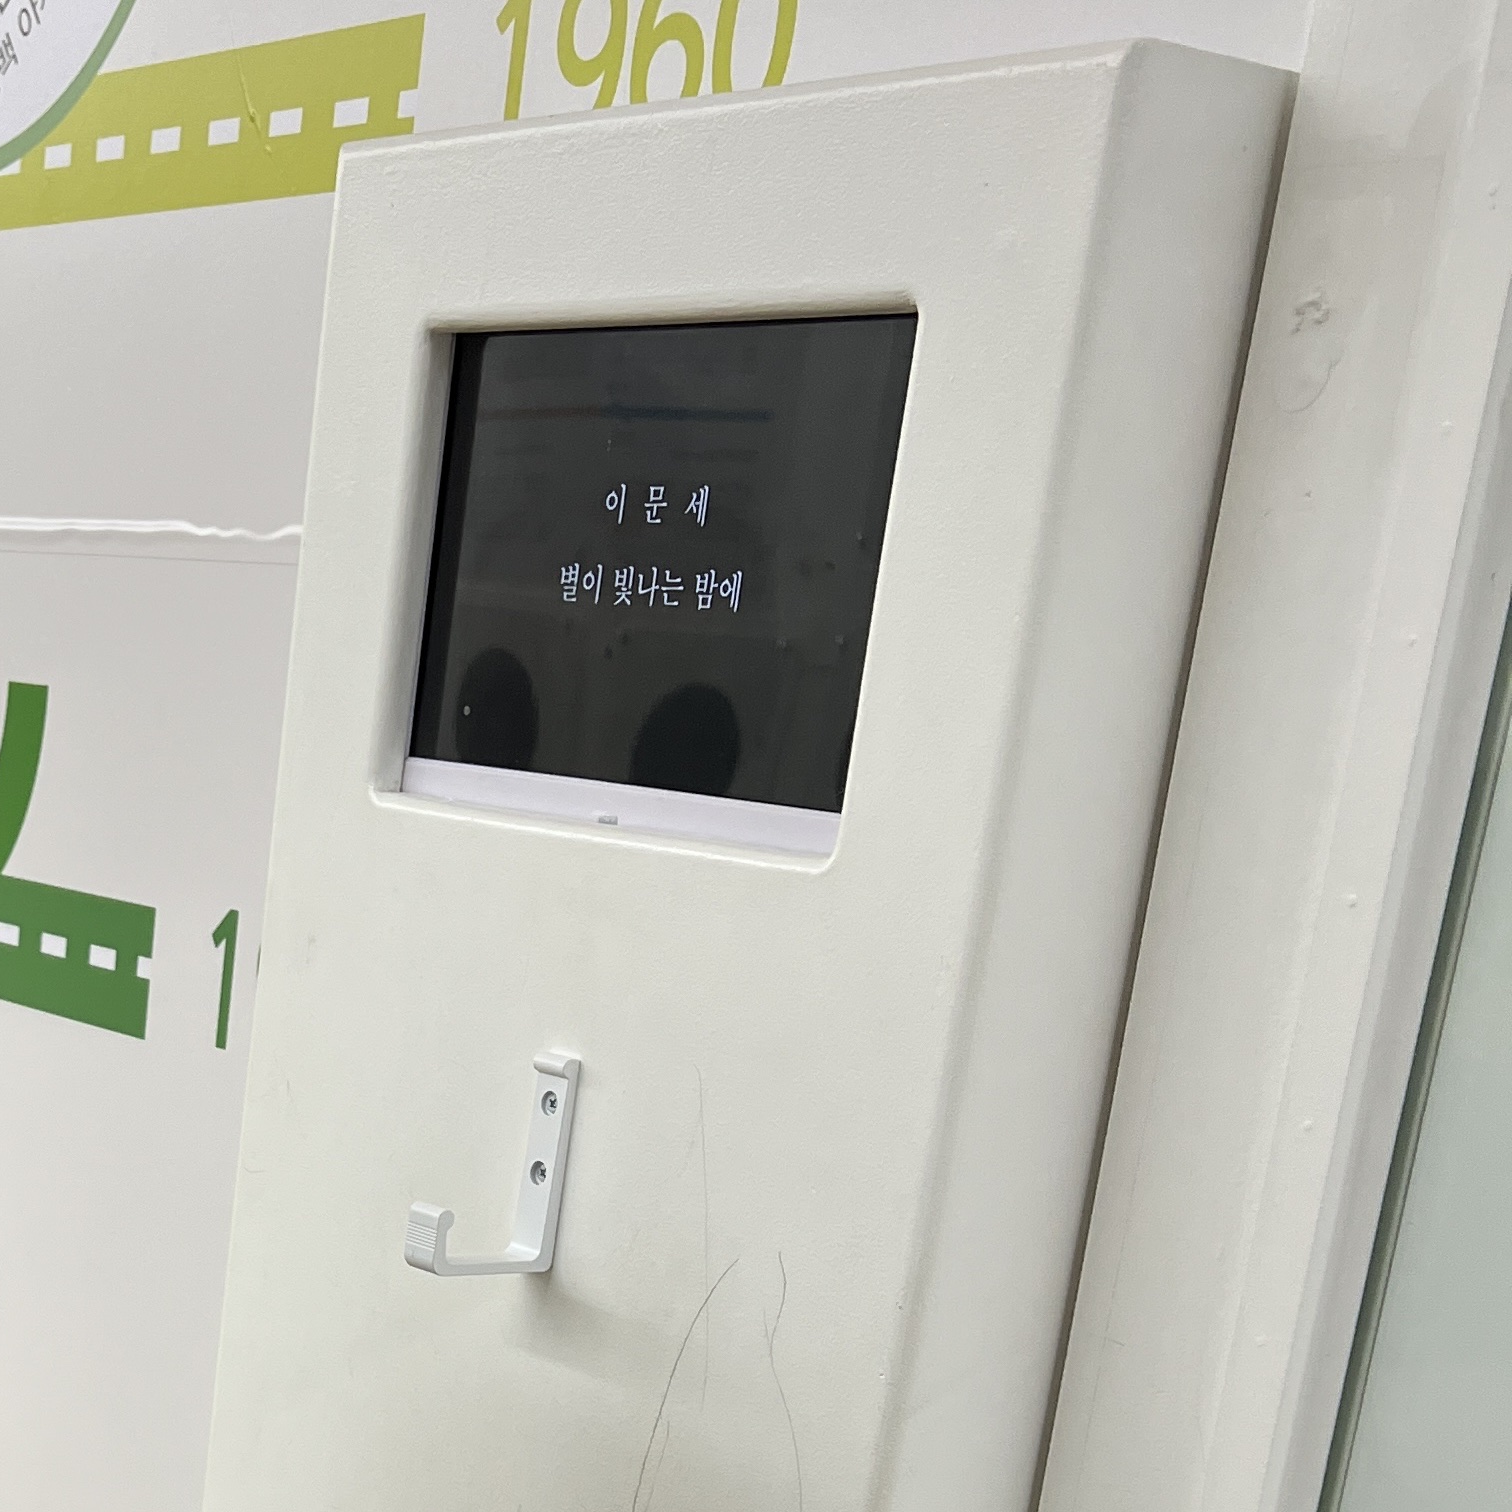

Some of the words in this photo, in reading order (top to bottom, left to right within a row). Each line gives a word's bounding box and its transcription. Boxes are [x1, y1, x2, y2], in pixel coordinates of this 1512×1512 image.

[605, 483, 627, 525] 이
[644, 486, 668, 524] 문
[684, 485, 709, 527] 세
[560, 562, 603, 605] 별이
[613, 565, 684, 607] 빛나는
[695, 569, 743, 613] 밤에
